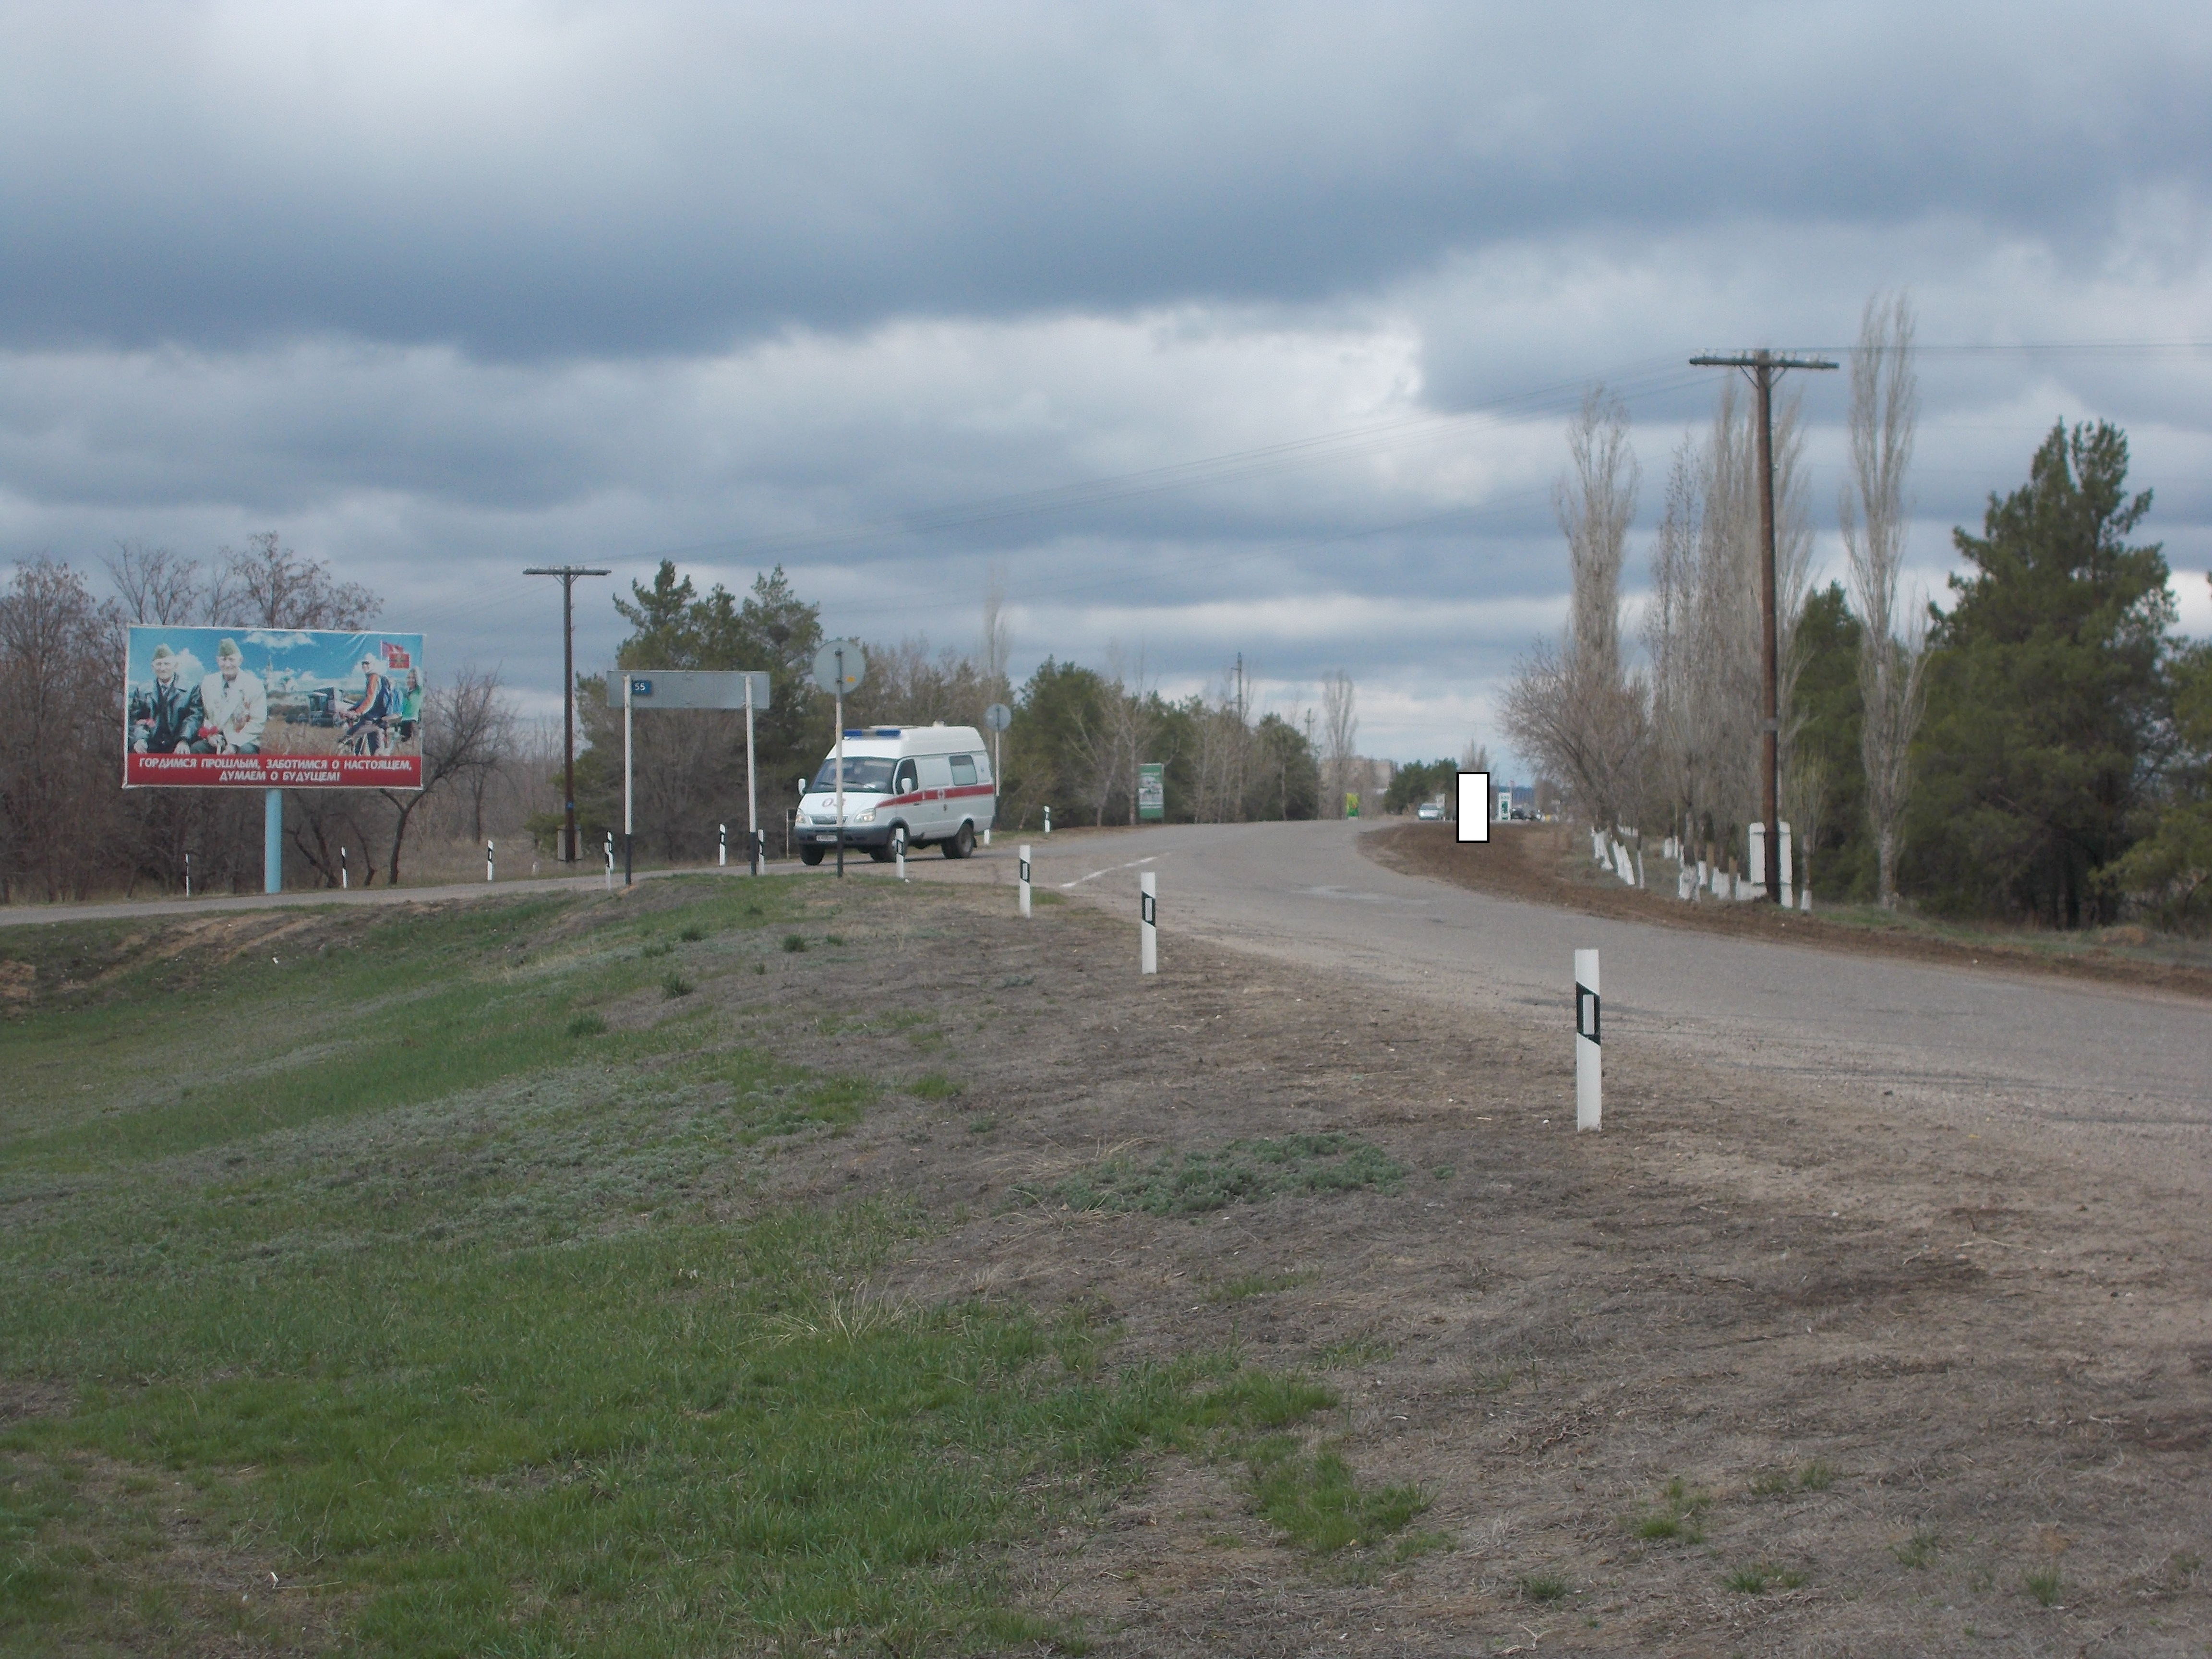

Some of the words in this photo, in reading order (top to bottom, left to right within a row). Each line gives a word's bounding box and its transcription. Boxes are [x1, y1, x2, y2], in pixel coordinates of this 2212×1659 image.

[635, 683, 645, 691] 55
[139, 758, 197, 769] ГОРДИМСЯ
[201, 758, 260, 769] ПРОШЛЫМ,
[266, 758, 327, 769] ЗАБОТИМСЯ
[332, 760, 339, 769] О
[344, 760, 412, 770] НАСТОЯЩЕМ,
[219, 770, 266, 781] ДУМАЕМ
[270, 771, 278, 781] О
[282, 771, 340, 782] БУДУЩЕМ!
